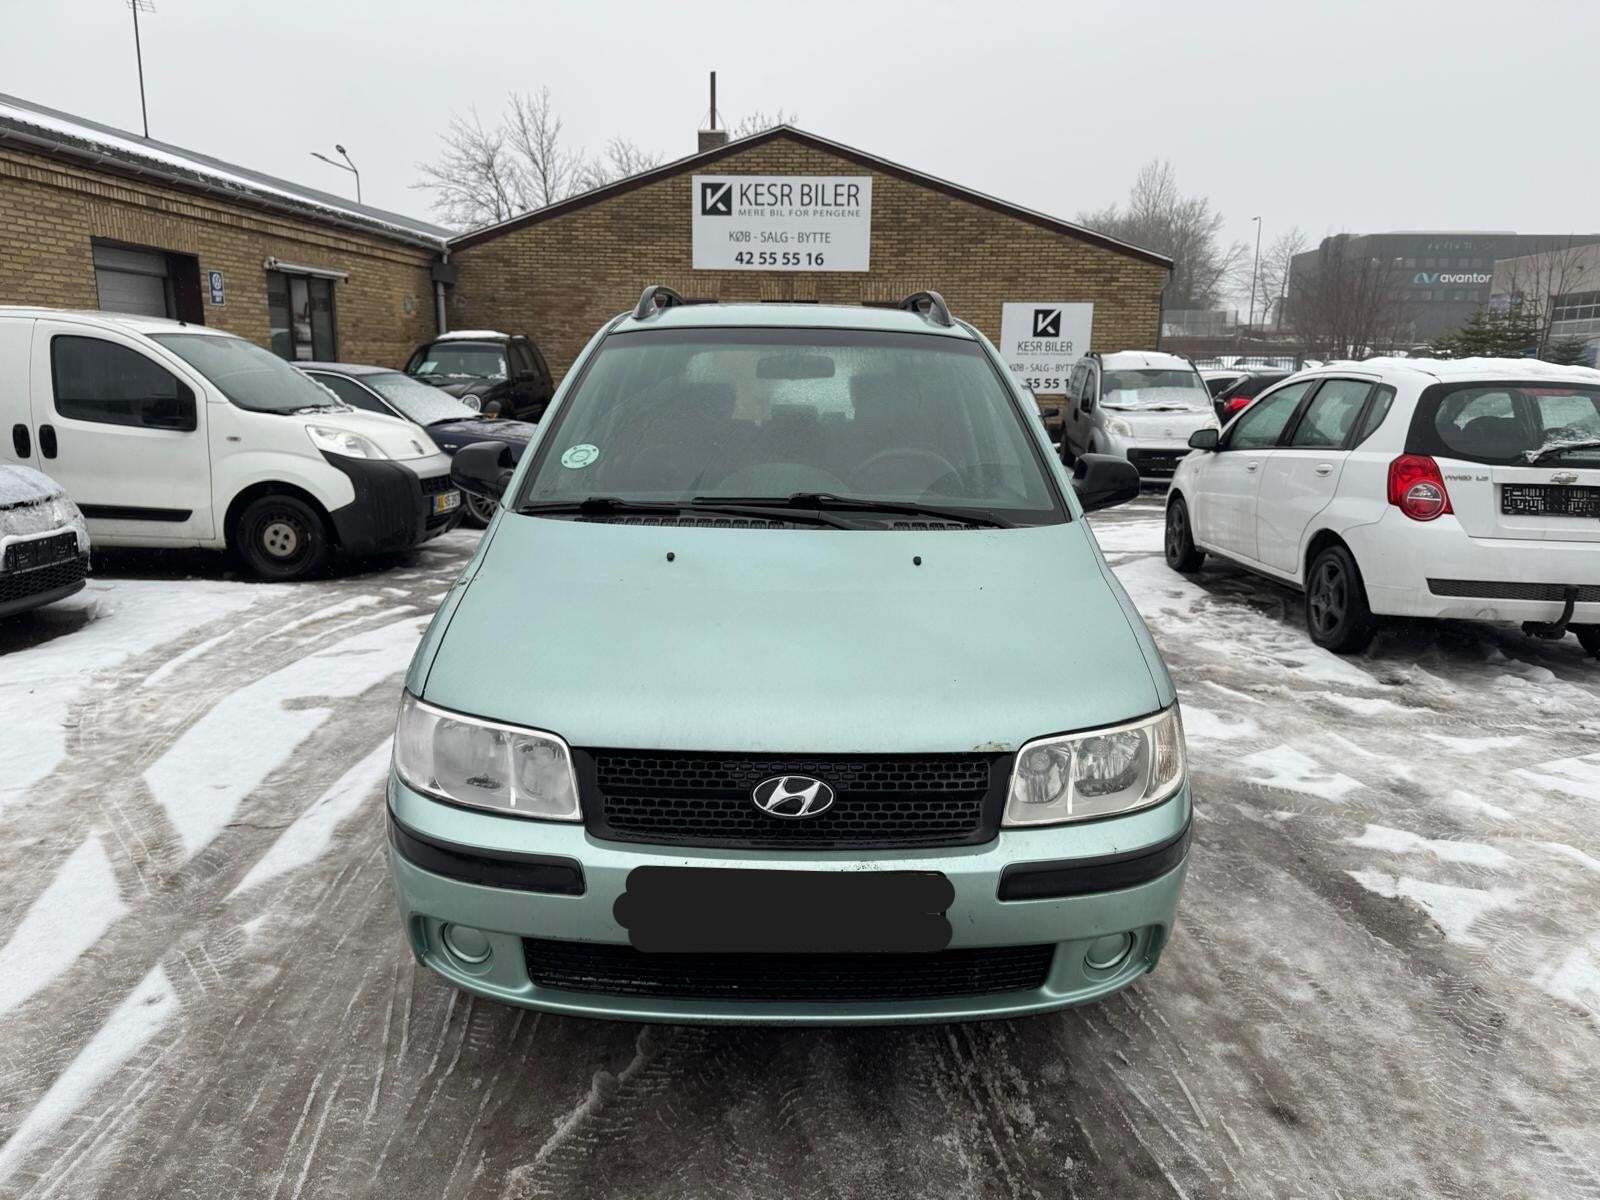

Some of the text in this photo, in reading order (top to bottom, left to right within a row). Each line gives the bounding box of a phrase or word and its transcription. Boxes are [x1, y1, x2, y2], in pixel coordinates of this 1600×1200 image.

[740, 183, 860, 207] KESR BILER
[738, 209, 861, 218] MERE BIL FOR PENGENE
[729, 231, 752, 243] KØB
[760, 232, 789, 243] SALG
[797, 232, 831, 244] BYTTE
[735, 252, 825, 266] 42 55 55 16
[1440, 273, 1492, 283] avantor
[1017, 341, 1073, 352] KESR BILER
[1030, 363, 1050, 372] SALG
[1044, 378, 1060, 389] 55
